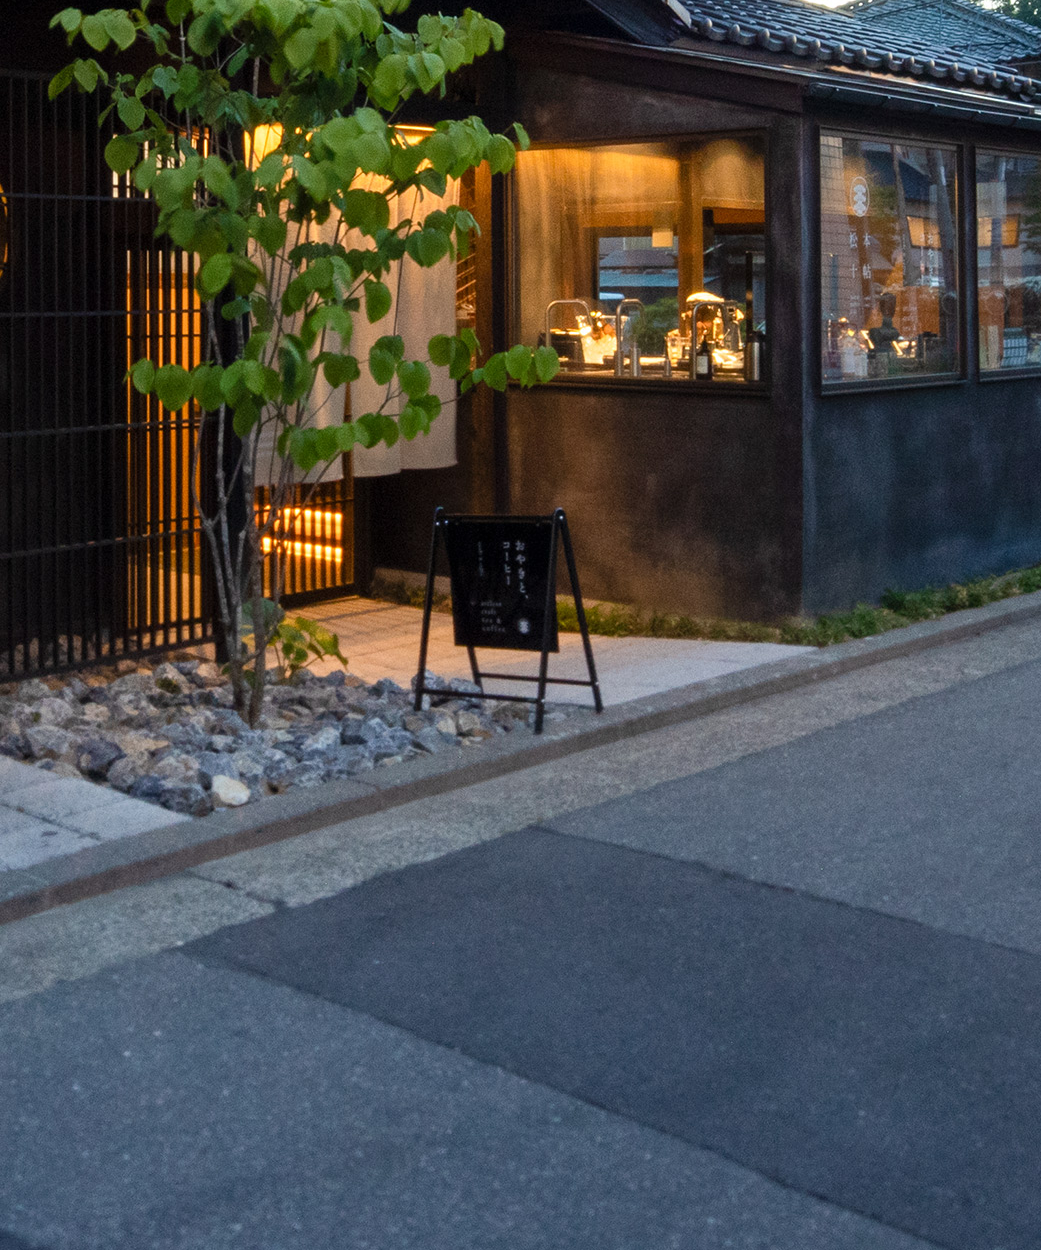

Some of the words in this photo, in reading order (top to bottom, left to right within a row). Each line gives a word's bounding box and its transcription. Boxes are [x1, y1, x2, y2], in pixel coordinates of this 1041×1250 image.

[503, 541, 511, 585] コーヒー
[515, 540, 529, 599] おやきと、
